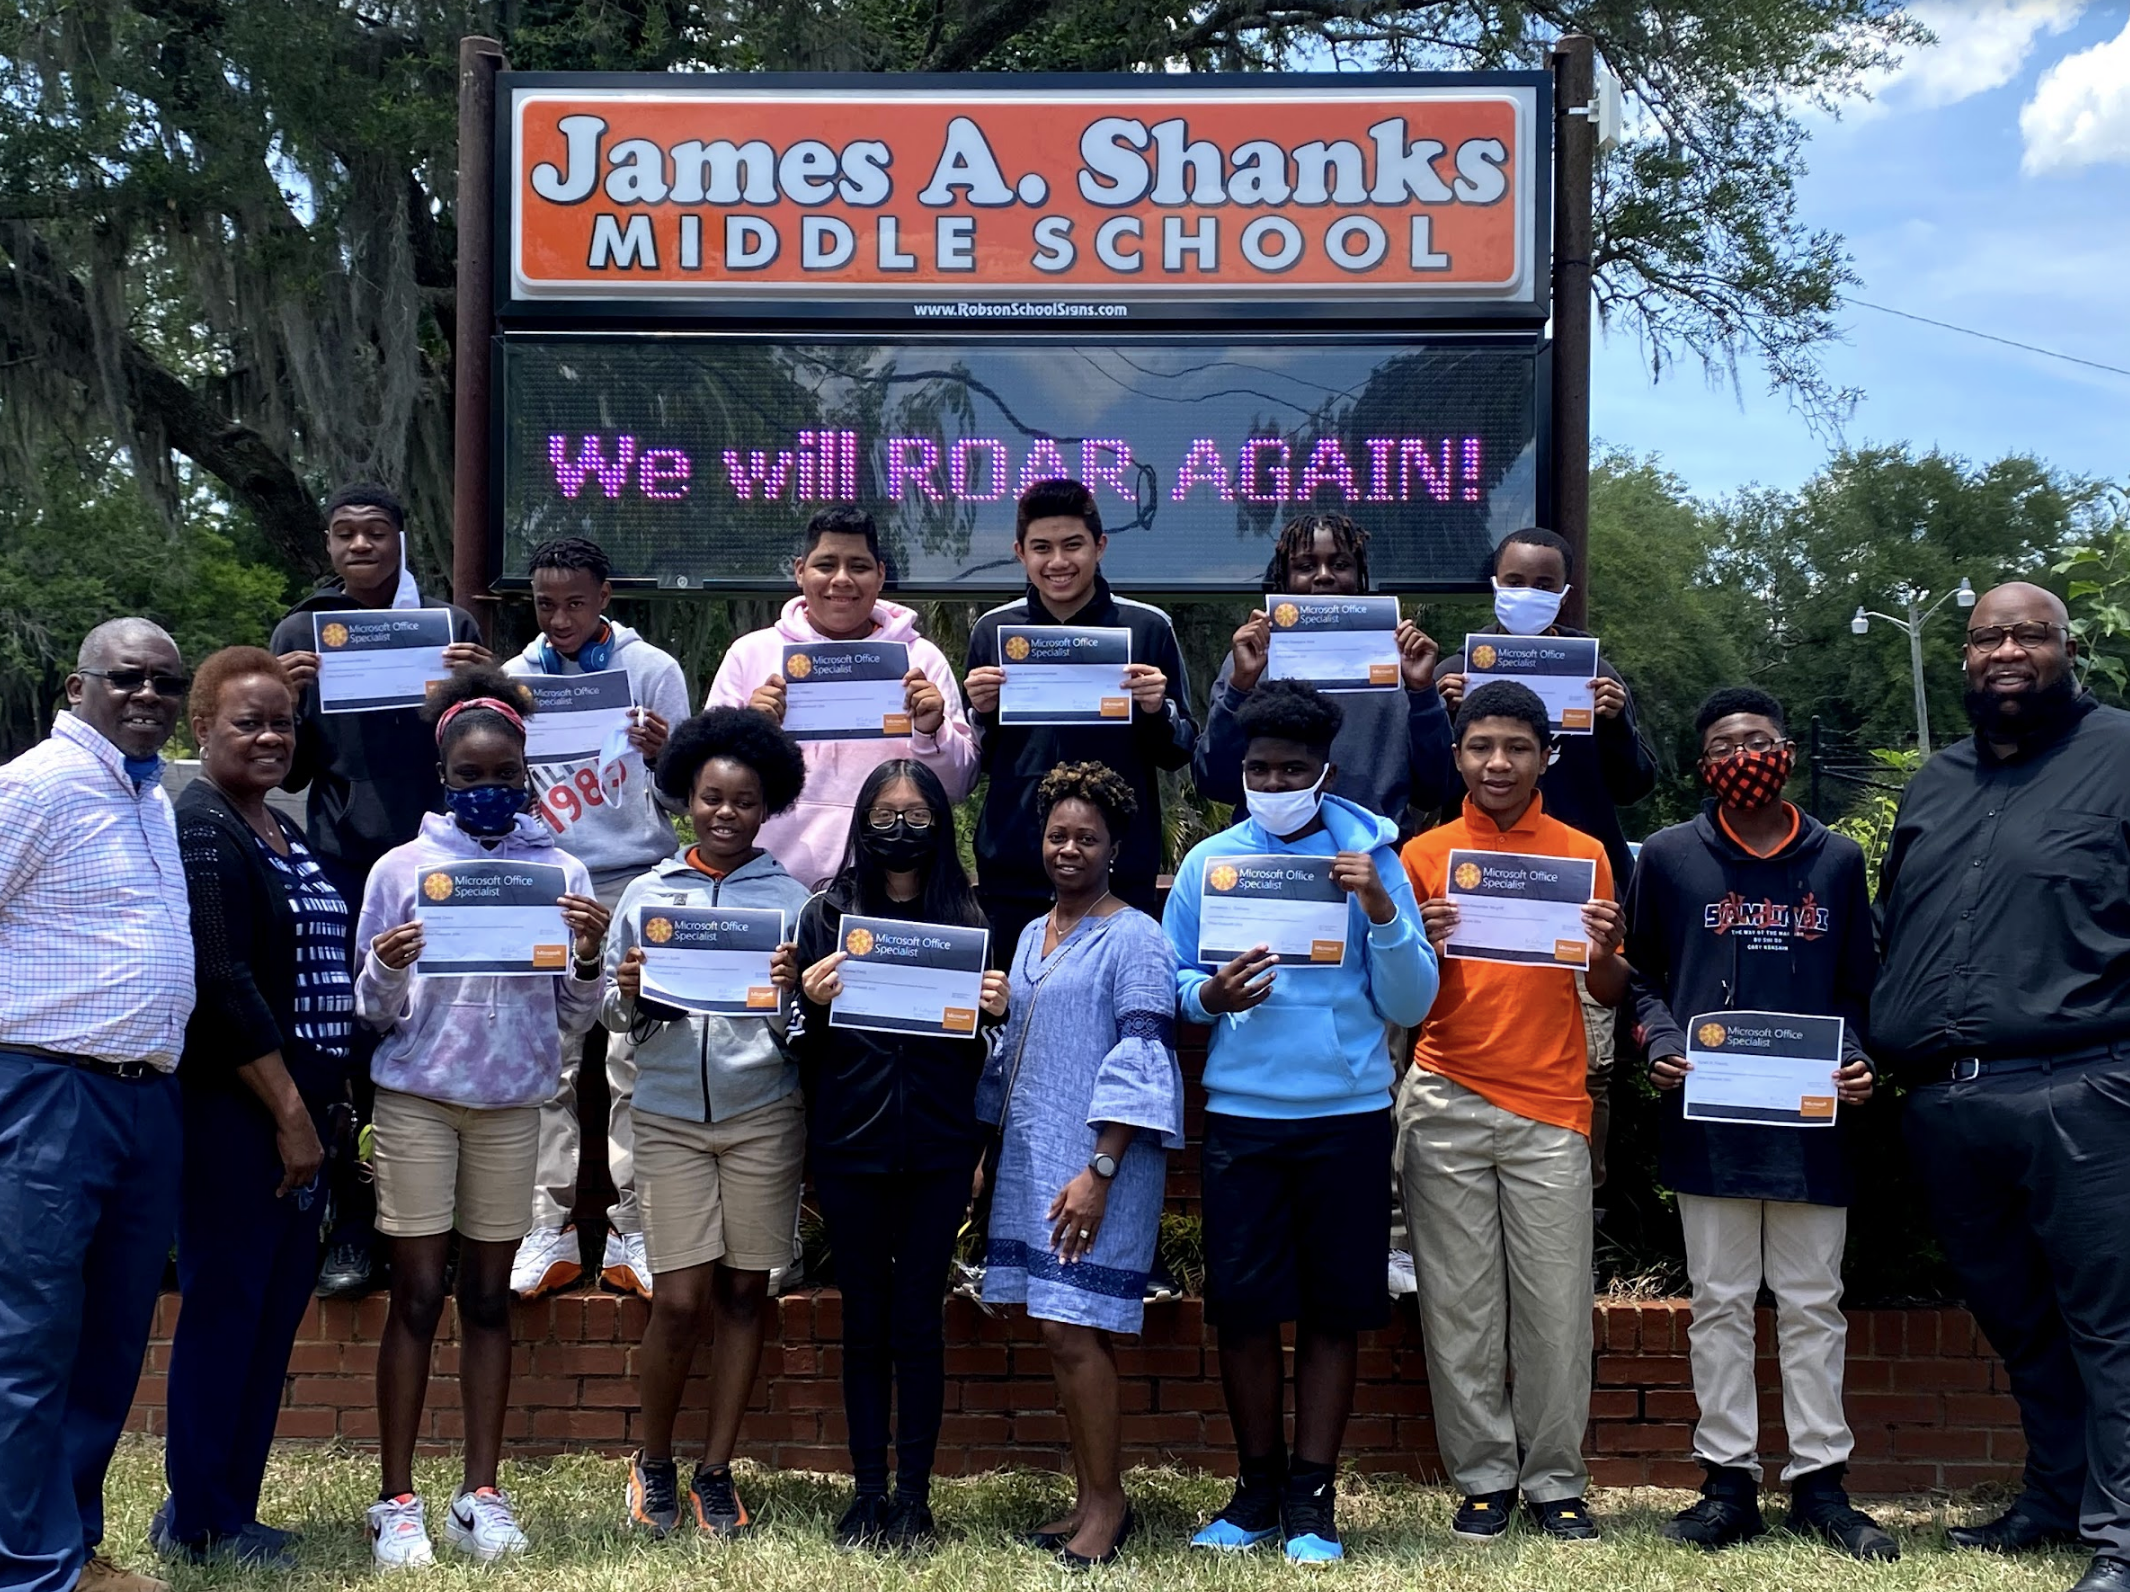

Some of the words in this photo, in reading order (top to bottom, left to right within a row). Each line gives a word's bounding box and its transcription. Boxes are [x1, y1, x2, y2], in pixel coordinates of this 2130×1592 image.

[531, 115, 893, 206] James
[917, 116, 1049, 207] A.
[1077, 116, 1509, 207] Shanks
[587, 213, 976, 272] MIDDLE
[1031, 214, 1452, 272] SCHOOL
[548, 434, 691, 498] We
[722, 430, 857, 500] will
[888, 438, 1137, 501] ROAR
[1171, 437, 1481, 501] AGAIN!
[1299, 605, 1339, 614] Microsoft
[1341, 604, 1367, 614] Office
[348, 622, 391, 633] Microsoft
[392, 621, 419, 631] Office
[1030, 637, 1071, 647] Microsoft
[1072, 637, 1098, 647] Office
[812, 654, 852, 665] Microsoft
[854, 653, 881, 663] Office
[1497, 648, 1538, 659] Microsoft
[1539, 649, 1565, 660] Office
[533, 688, 572, 697] Microsoft
[573, 686, 600, 696] Office
[454, 875, 501, 886] Microsoft
[503, 875, 533, 886] Office
[1239, 868, 1284, 880] Microsoft
[1285, 870, 1315, 881] Office
[1482, 867, 1527, 880] Microsoft
[1529, 870, 1558, 883] Office
[674, 920, 718, 931] Microsoft
[720, 921, 749, 932] Office
[875, 933, 920, 947] Microsoft
[922, 937, 951, 950] Office
[1727, 1026, 1772, 1038] Microsoft
[1774, 1028, 1804, 1040] Office
